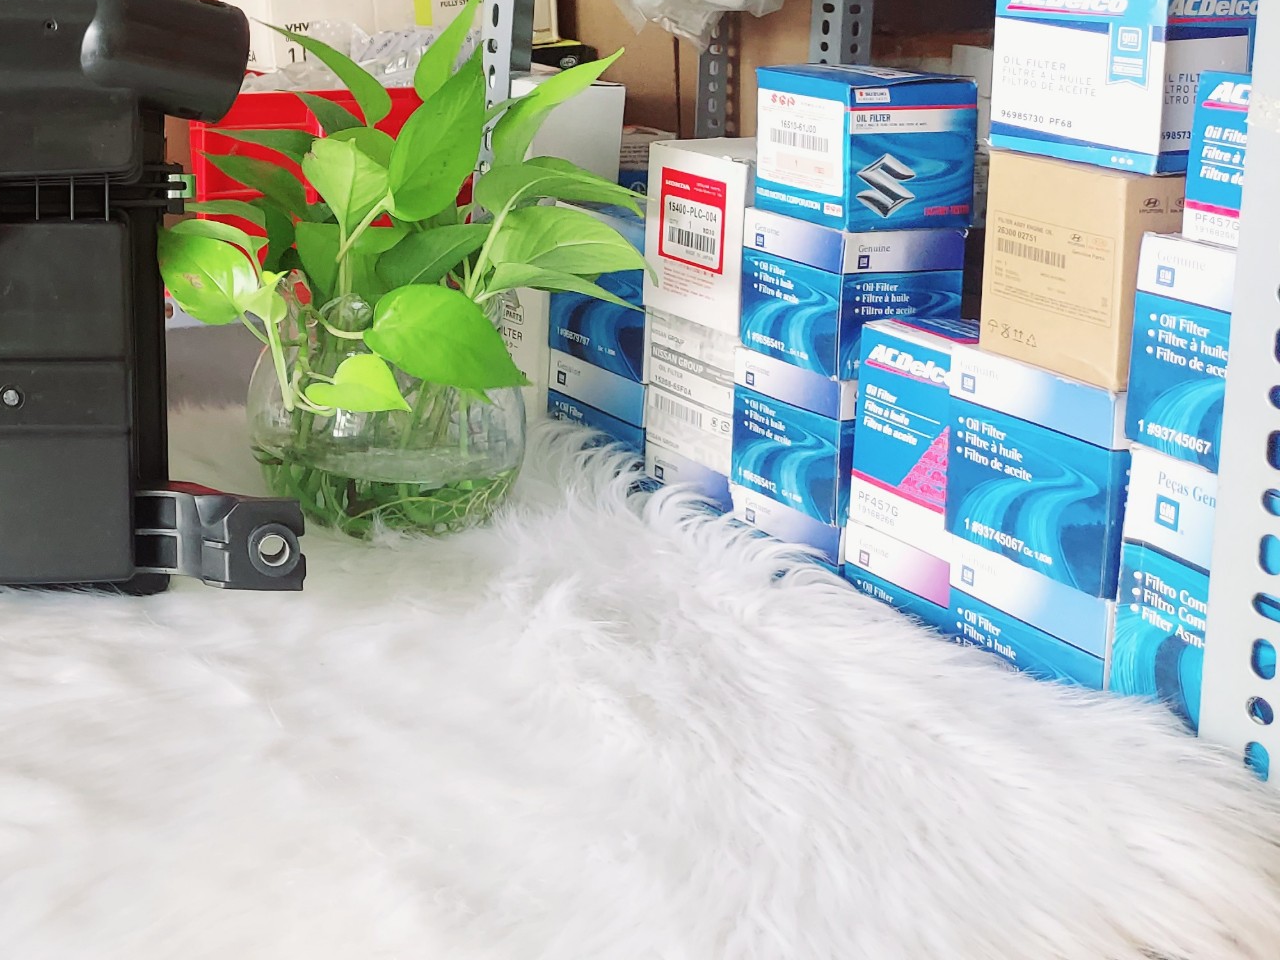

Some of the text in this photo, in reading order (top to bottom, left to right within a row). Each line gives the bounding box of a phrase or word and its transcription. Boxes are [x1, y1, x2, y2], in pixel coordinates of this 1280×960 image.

[1121, 31, 1138, 45] gm
[1002, 54, 1066, 72] OIL FILTER
[1001, 66, 1093, 87] FILTRE HUILE
[1001, 76, 1097, 99] FILTRO DE ACEITE
[780, 119, 817, 134] 16510-61J00
[856, 113, 891, 124] OIL FILTER
[1001, 109, 1073, 129] 96985730 PF68
[1204, 124, 1221, 139] Oil
[1201, 145, 1239, 164] Filtre à
[665, 179, 691, 191] HONDA
[1199, 165, 1245, 186] Filtro de
[668, 200, 717, 224] 15400-PLC-004
[1195, 212, 1240, 232] PF457G
[997, 225, 1037, 244] 26300 02751
[857, 243, 891, 253] Genuine
[1156, 247, 1208, 273] Genuine
[1158, 267, 1173, 285] GM
[862, 282, 899, 292] Oil Filter
[861, 293, 910, 303] Filtre huile
[861, 306, 895, 316] Filtro de
[1159, 313, 1212, 340] Oil Filter
[1157, 329, 1229, 361] Filtre à huile
[652, 344, 704, 375] NISSAN GROUP
[1156, 346, 1205, 372] Filtro de
[965, 417, 1008, 441] Oil Filter
[1136, 418, 1213, 456] 1 #93745067
[964, 431, 1024, 463] Filtre à huile
[963, 446, 1033, 483] Filtro de aceite
[1157, 470, 1190, 498] Peças
[970, 519, 1025, 554] #93745067
[1144, 571, 1177, 600] Filtro
[1143, 588, 1176, 617] Filtro
[1140, 605, 1173, 634] Filter
